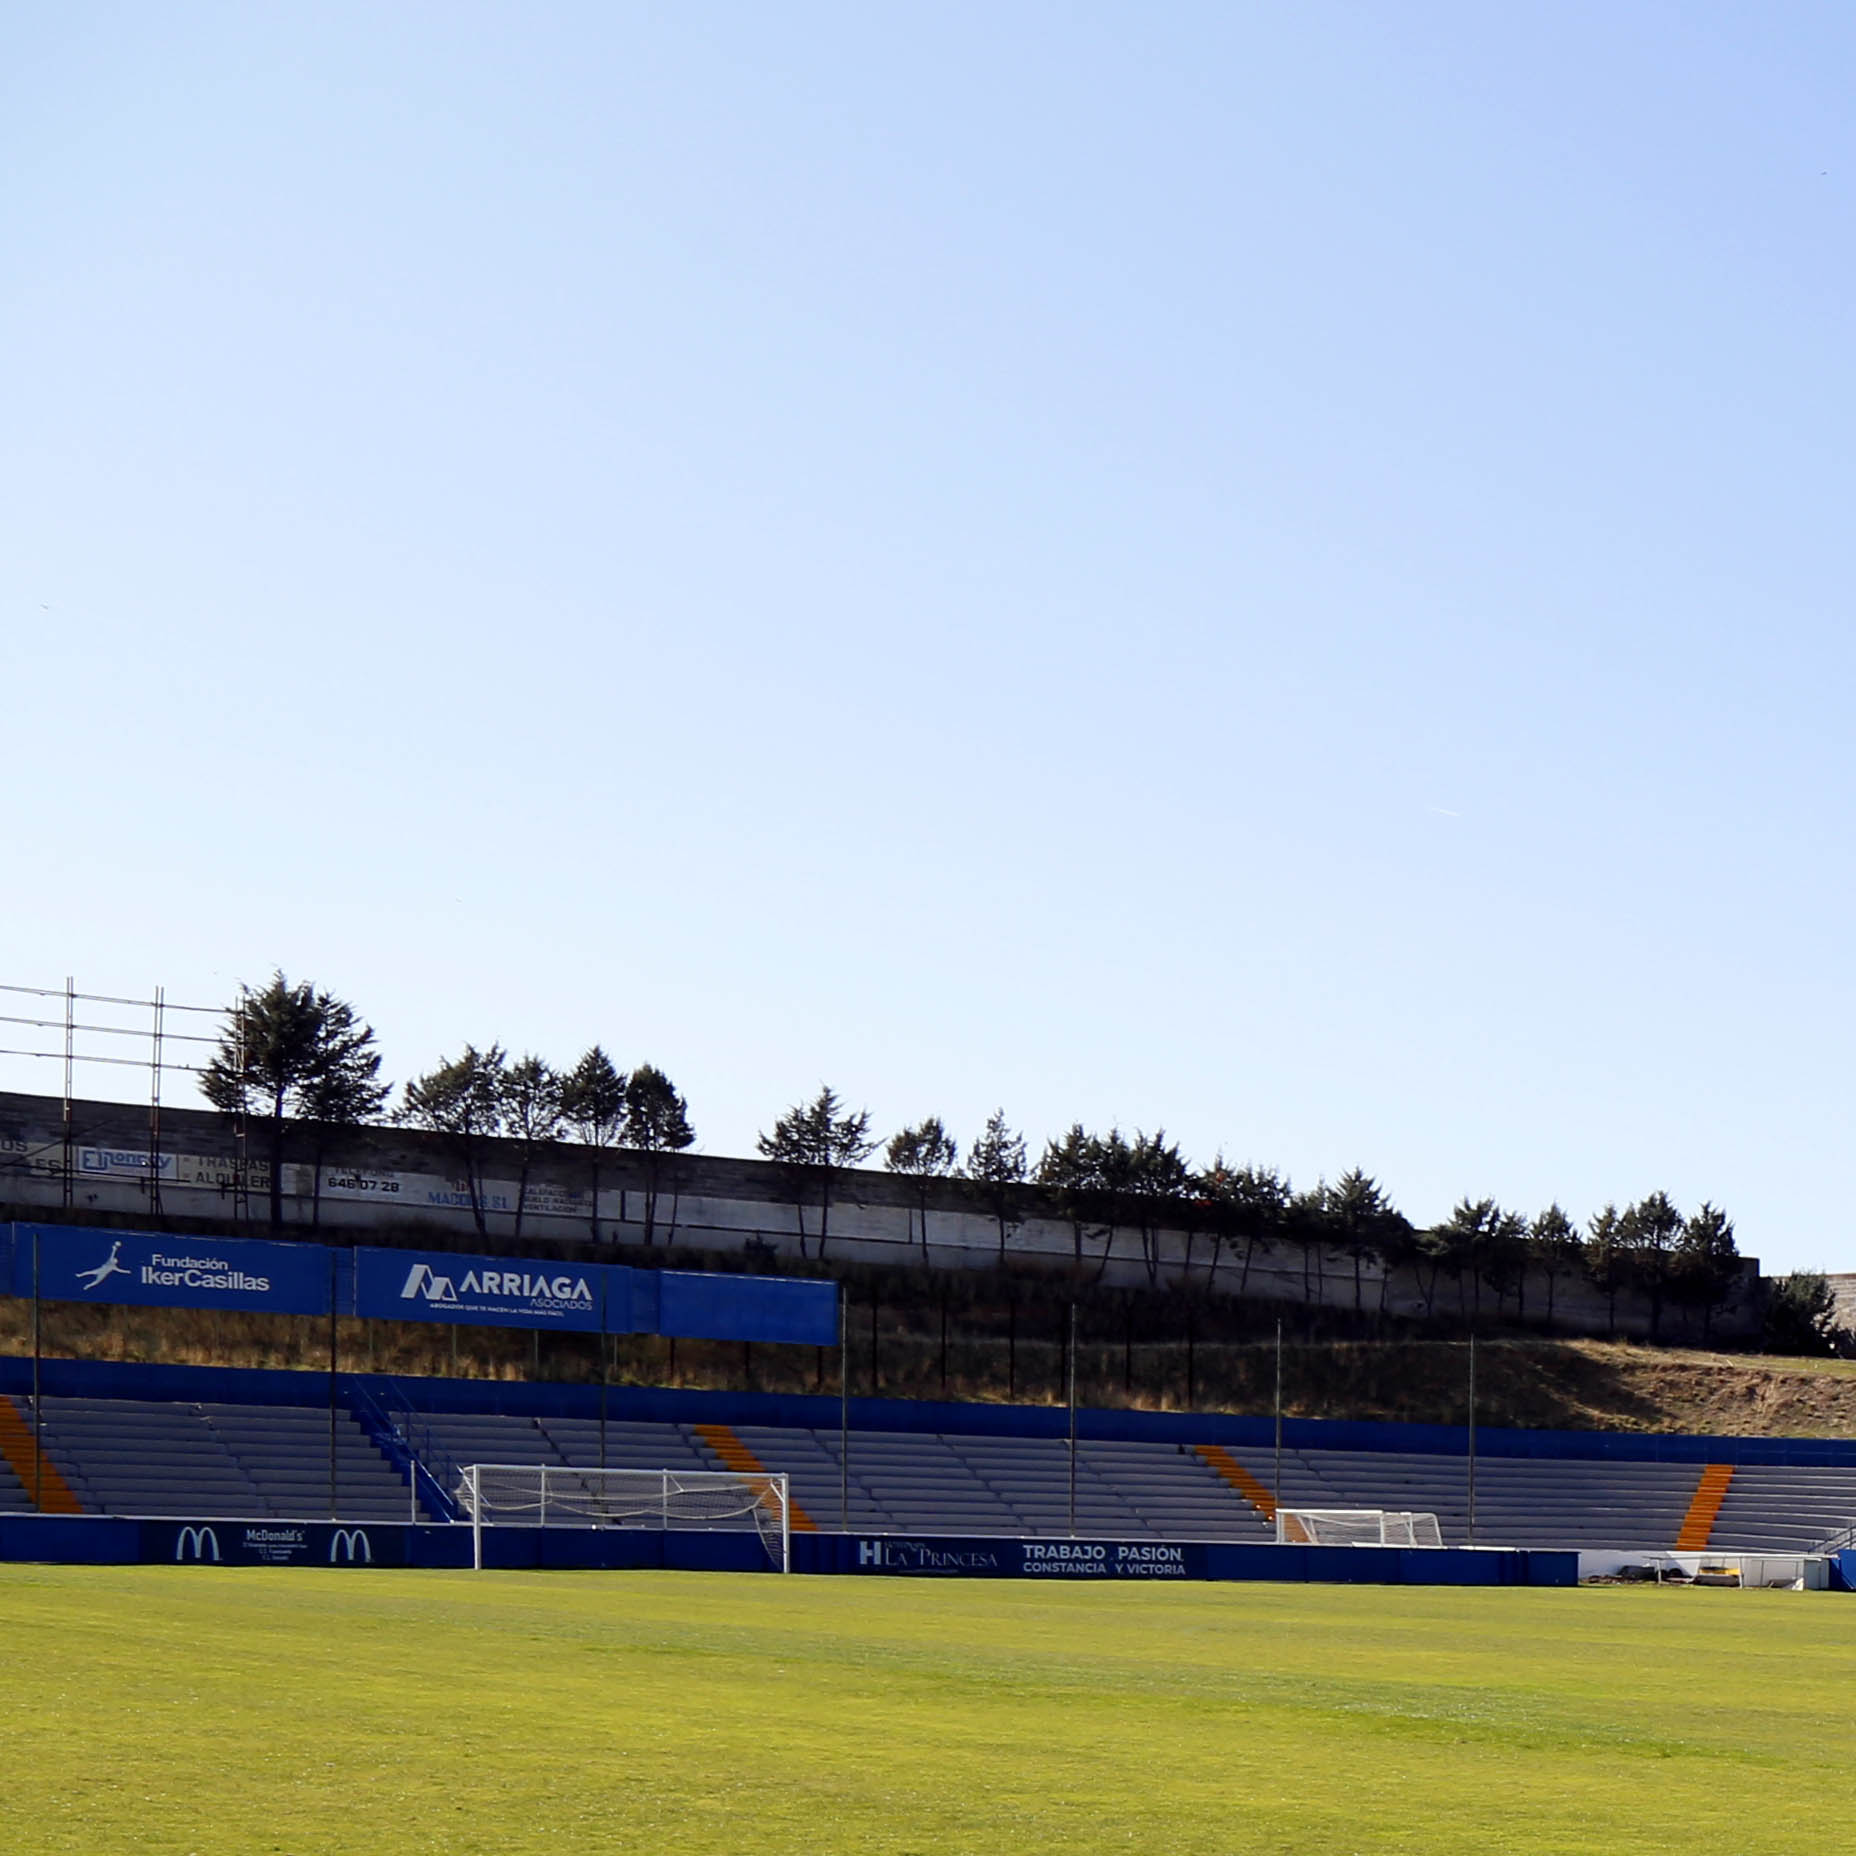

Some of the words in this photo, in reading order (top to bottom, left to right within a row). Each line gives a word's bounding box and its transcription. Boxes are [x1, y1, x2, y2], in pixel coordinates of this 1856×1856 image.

[152, 1254, 228, 1270] Fundación
[141, 1266, 270, 1291] IkerCasillas
[459, 1270, 593, 1300] ARRIAGA
[530, 1298, 593, 1311] ASOCIADOS
[246, 1529, 305, 1542] McDonald's
[1023, 1562, 1106, 1574] CONSTANCIA
[1115, 1563, 1124, 1574] Y
[1126, 1564, 1186, 1575] VICTORIA
